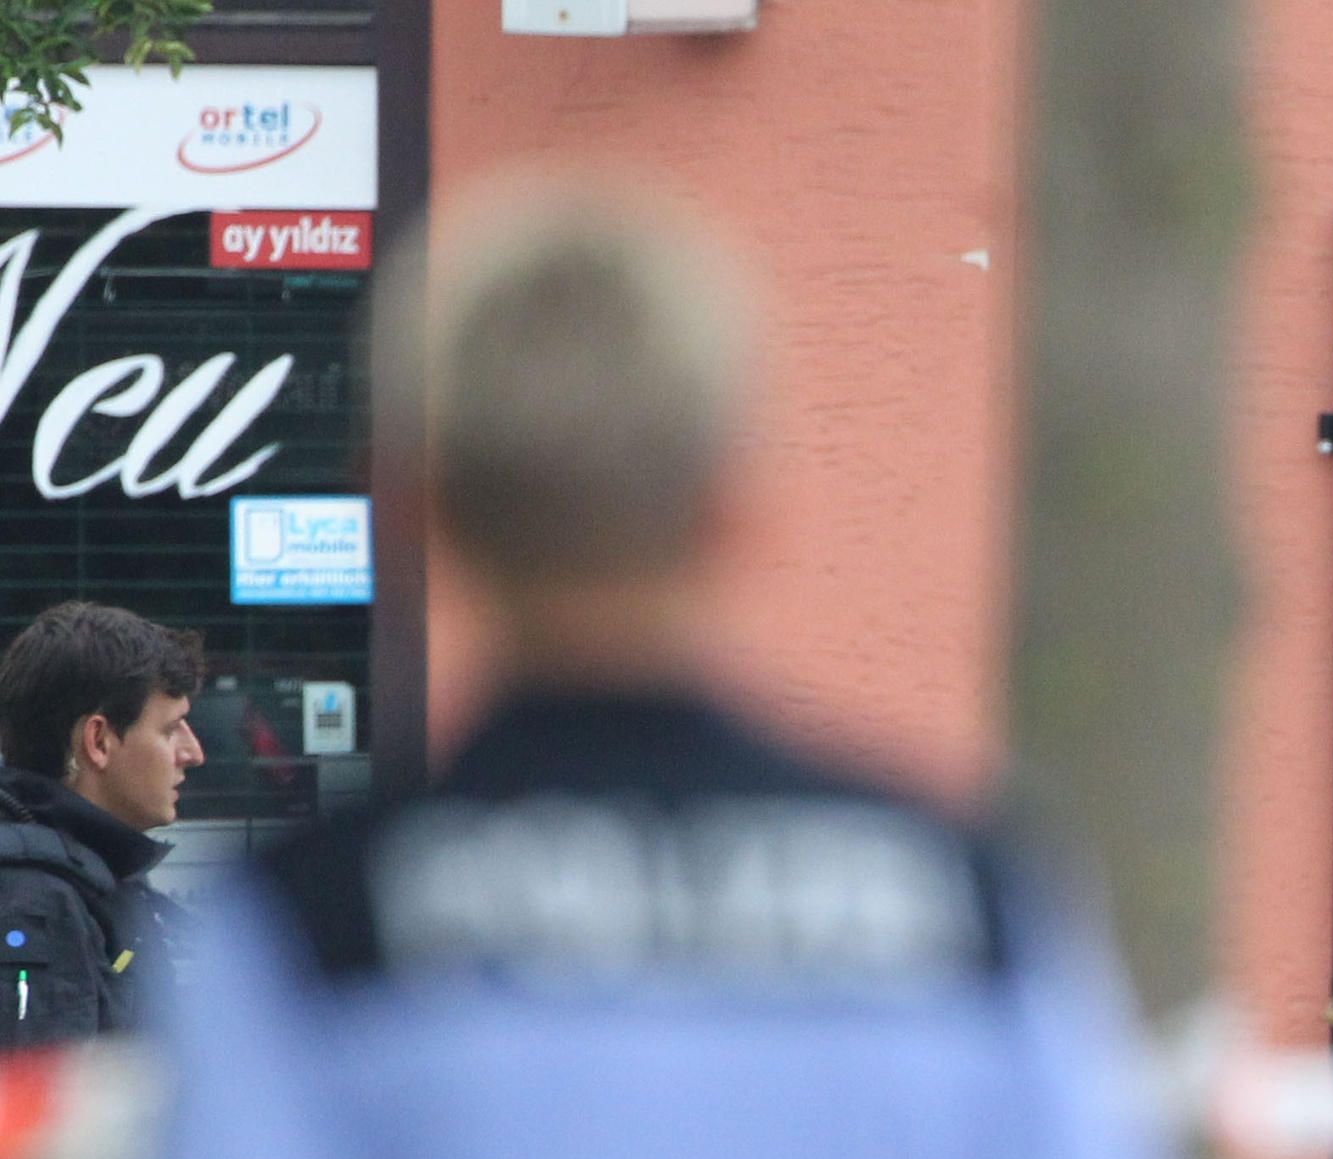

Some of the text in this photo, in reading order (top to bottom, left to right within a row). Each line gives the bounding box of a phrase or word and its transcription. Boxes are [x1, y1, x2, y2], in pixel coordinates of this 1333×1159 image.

[200, 101, 290, 132] ortel
[223, 223, 265, 262] ay
[287, 511, 359, 537] Lyca
